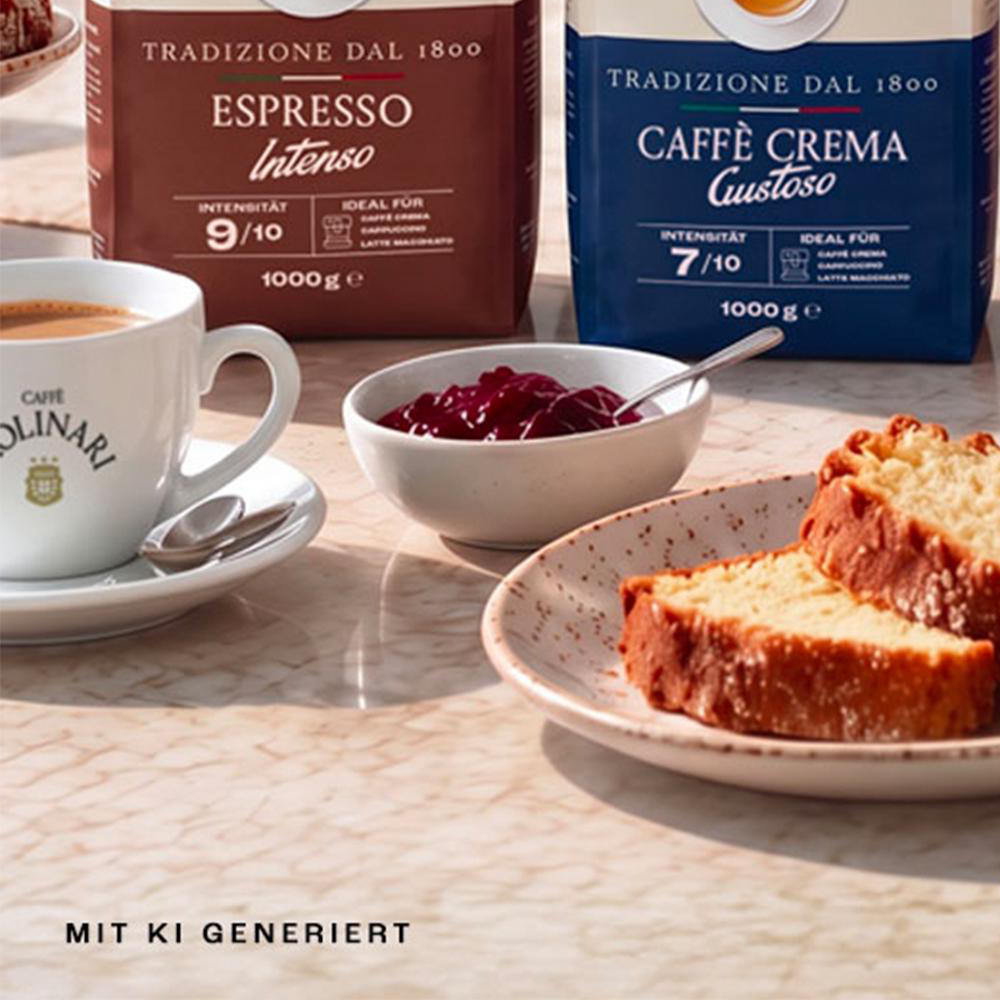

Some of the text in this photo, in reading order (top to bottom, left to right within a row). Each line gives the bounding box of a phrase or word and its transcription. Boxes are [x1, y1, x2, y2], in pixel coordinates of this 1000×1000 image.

[142, 40, 482, 62] TRADIZIONE DAL 1800
[607, 68, 938, 94] TRADIZIONE DAL 1800
[211, 93, 413, 128] ESPRESSO
[637, 120, 908, 162] CAFFÈ CREMA
[249, 137, 376, 182] Intenso
[707, 162, 837, 207] Gustoso
[199, 200, 288, 214] INTENSITÄT
[342, 196, 424, 212] IDEAL FÜR
[660, 230, 747, 244] INTENSITÄT
[800, 231, 881, 245] IDEAL FÜR
[0, 410, 117, 471] OLINARI
